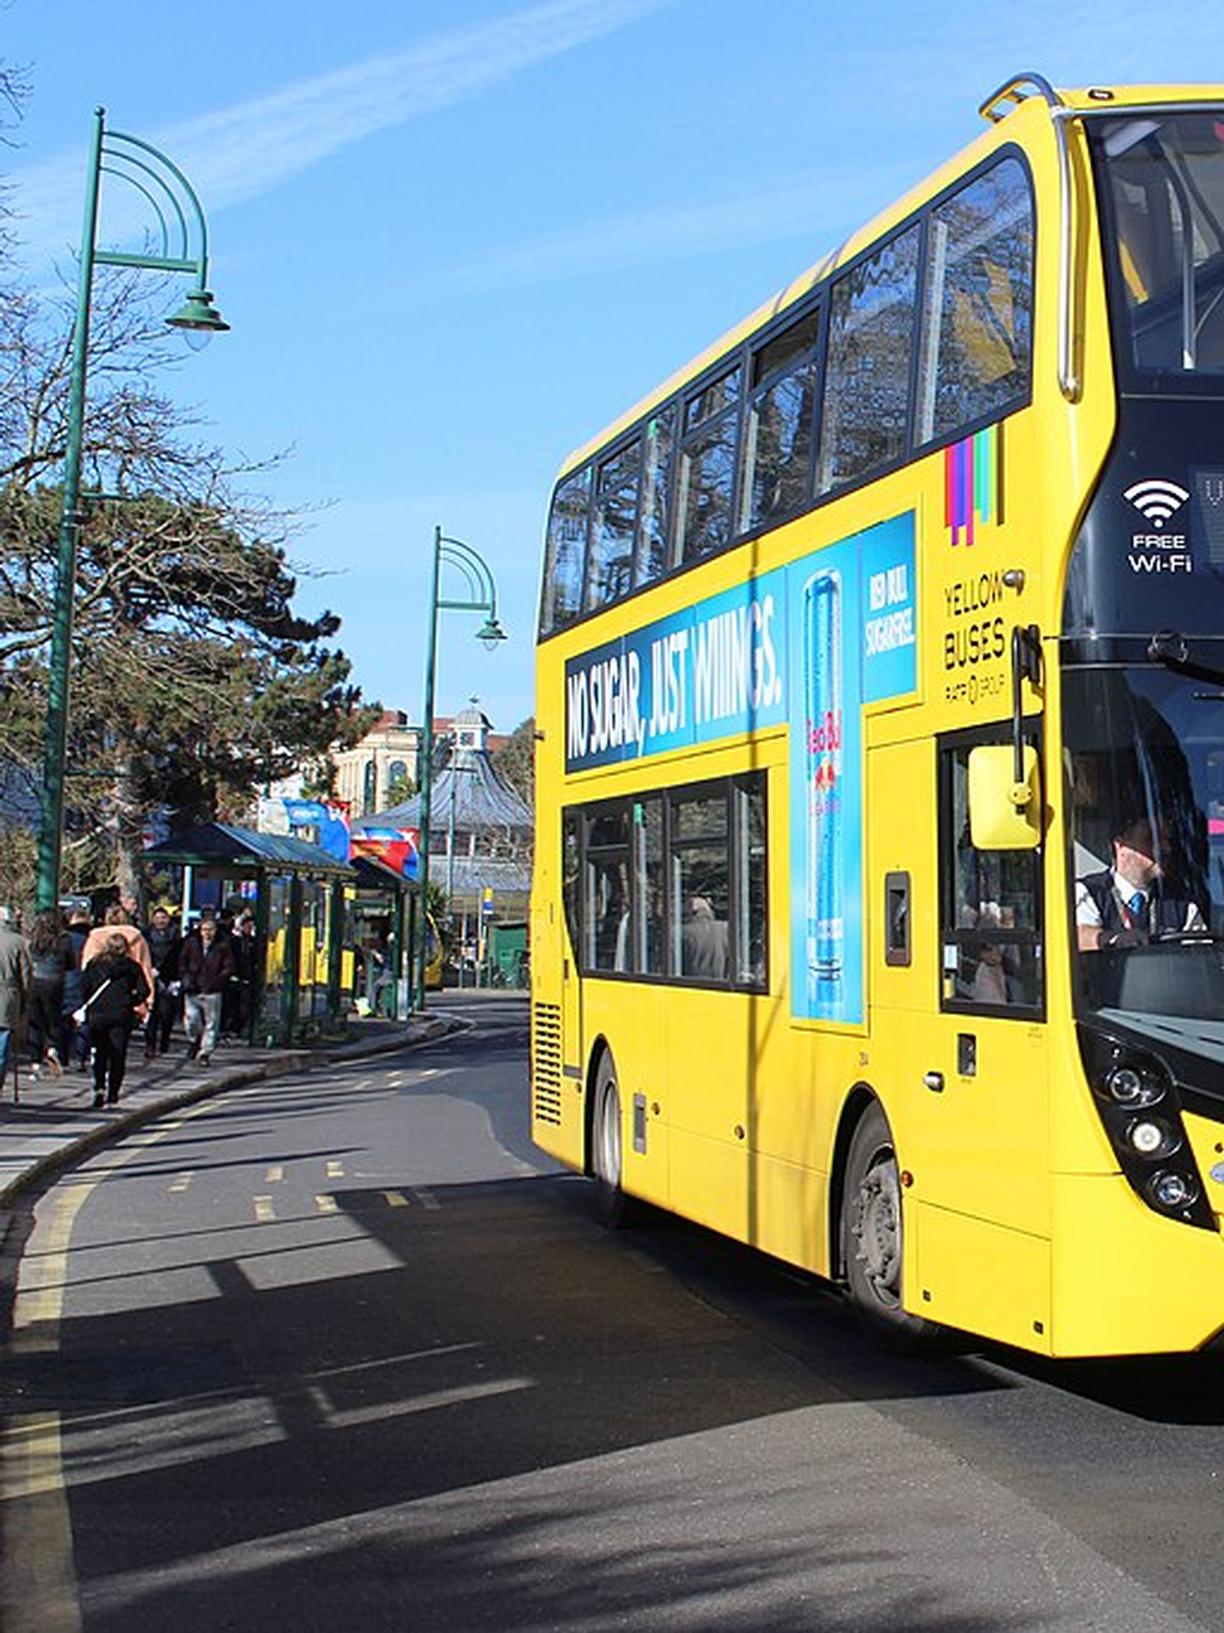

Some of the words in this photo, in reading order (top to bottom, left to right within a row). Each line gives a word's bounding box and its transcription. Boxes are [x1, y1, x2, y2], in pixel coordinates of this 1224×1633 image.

[1128, 555, 1192, 573] Wi-Fi
[1132, 535, 1186, 549] FREE
[944, 574, 1003, 618] YELLOW
[945, 618, 1005, 670] BUSES
[567, 670, 588, 759] NO
[590, 651, 646, 757] SUGAR,
[650, 629, 689, 737] JUST
